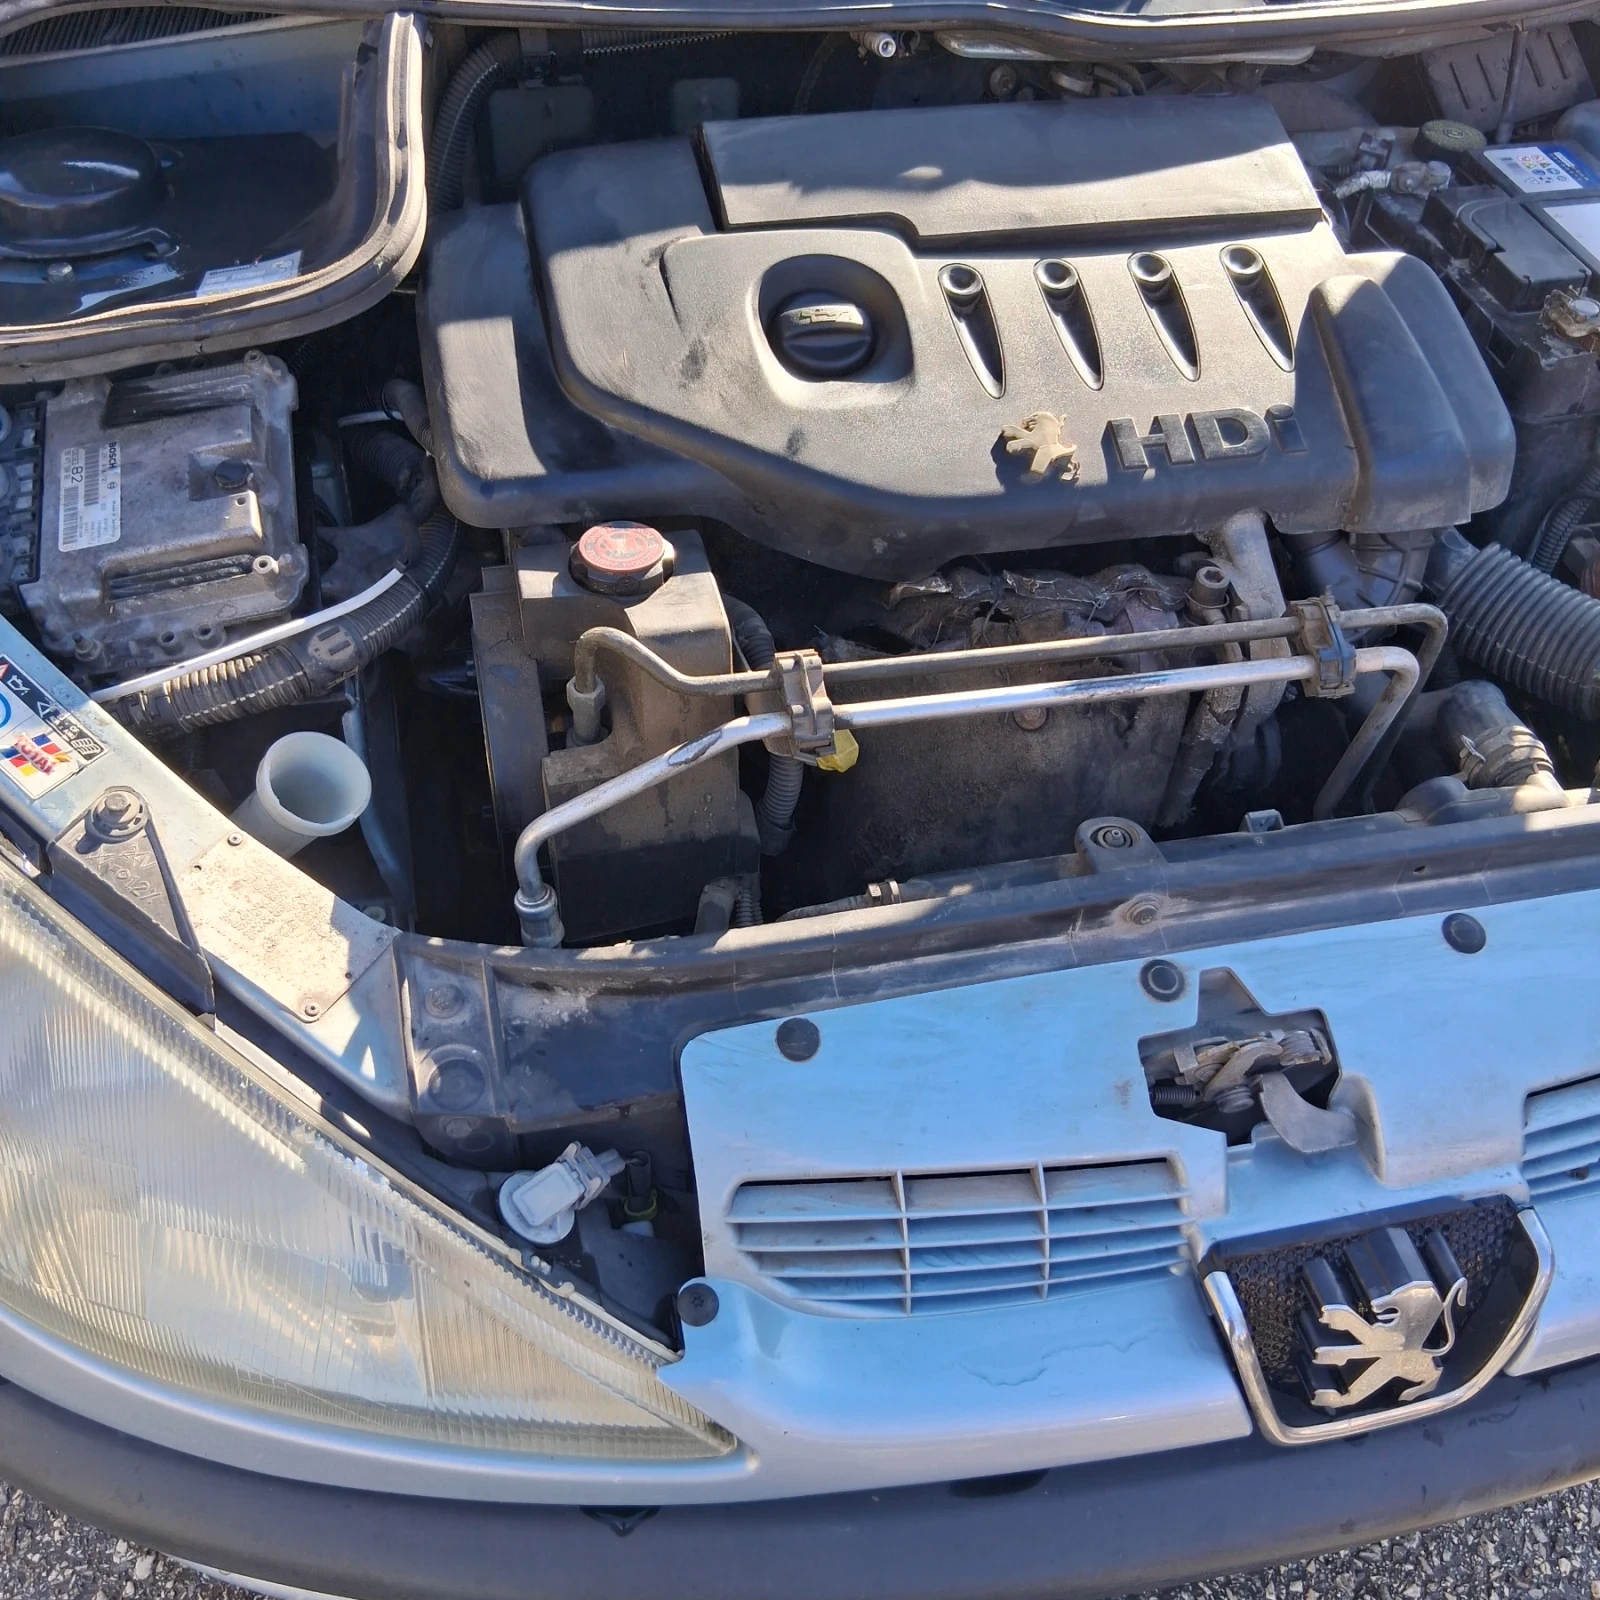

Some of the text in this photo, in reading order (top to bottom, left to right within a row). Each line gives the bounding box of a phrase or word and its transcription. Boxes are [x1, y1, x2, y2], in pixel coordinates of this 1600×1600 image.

[1107, 403, 1307, 470] HDi
[109, 441, 117, 469] BOSCH
[71, 465, 84, 484] 82
